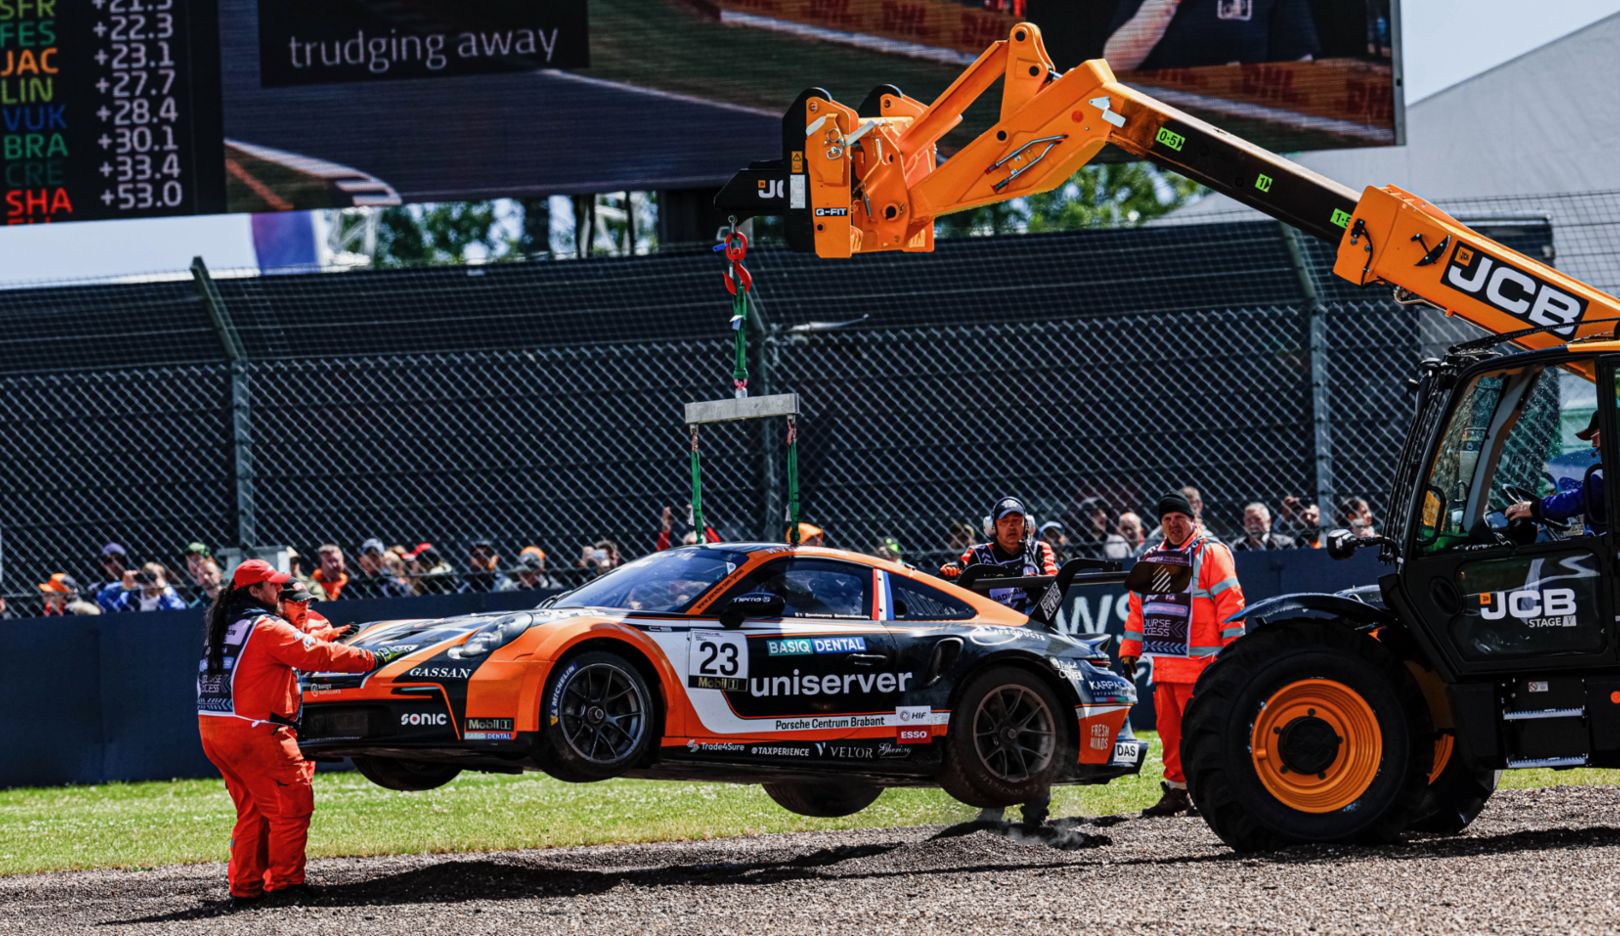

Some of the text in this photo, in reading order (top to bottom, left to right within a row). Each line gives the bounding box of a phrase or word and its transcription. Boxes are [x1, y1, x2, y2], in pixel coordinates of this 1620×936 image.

[0, 14, 174, 47] FES +22.3
[0, 42, 175, 76] JAC +23.1
[288, 27, 559, 73] trudging away
[1, 69, 177, 104] LIN +27.7
[3, 97, 179, 131] VUK +28.4
[4, 126, 179, 159] BRA +30.1
[4, 153, 181, 187] CRE +33.4
[6, 181, 183, 216] SHA +53.0
[815, 208, 847, 217] G-FIT
[1448, 256, 1581, 335] JCB
[1480, 588, 1577, 620] JCB
[1529, 618, 1562, 628] STAGE
[699, 641, 739, 676] 23
[769, 639, 865, 654] BASIQ DENTAL
[410, 667, 472, 679] GASSAN
[698, 677, 727, 689] Mobil
[751, 669, 913, 697] uniserver
[469, 719, 499, 730] Mobil
[775, 716, 885, 730] Porsche Centrum Brabant
[912, 712, 926, 720] HIF
[701, 741, 745, 752] Trade4Sure
[901, 731, 928, 739] ESSO
[1117, 745, 1136, 757] DAS
